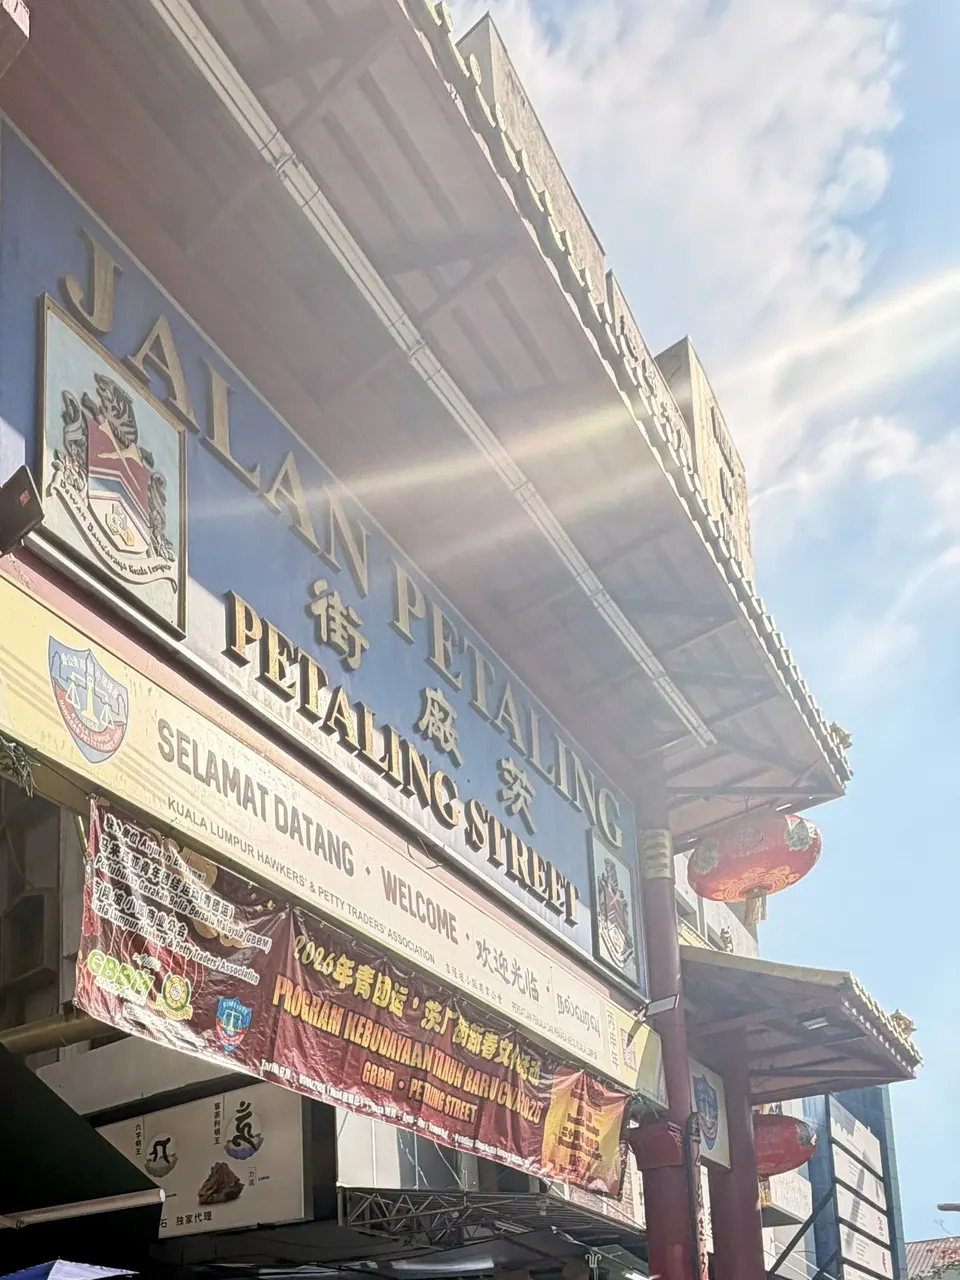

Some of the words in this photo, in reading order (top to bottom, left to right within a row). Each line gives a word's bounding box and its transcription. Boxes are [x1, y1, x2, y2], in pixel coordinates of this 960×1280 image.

[58, 227, 371, 598] JALAN
[388, 559, 624, 848] PETALING
[156, 717, 270, 824] SELAMAT
[273, 792, 355, 877] DATANG
[221, 588, 461, 830] PETALING
[464, 798, 581, 928] STREET
[167, 796, 207, 830] KUALA
[209, 823, 255, 858] LUMPUR
[256, 850, 308, 887] HAWKERS'
[309, 880, 317, 894] &
[317, 885, 345, 911] PETTY
[346, 902, 387, 934] TRADERS'
[387, 929, 436, 965] ASSOCIATION
[379, 864, 459, 946] WELCOME
[174, 940, 192, 960] Petty
[219, 958, 259, 985] Association
[243, 929, 272, 954] (GBBM)
[293, 935, 410, 1018] 2026年青团运
[476, 938, 539, 1003] 欢迎光临
[272, 974, 346, 1036] PROGRAM
[343, 1011, 433, 1073] KEBUDAYAAN
[431, 1048, 466, 1089] TAHUN
[463, 1066, 500, 1101] BARU
[361, 1060, 396, 1092] GBBM
[445, 1094, 478, 1123] STREET
